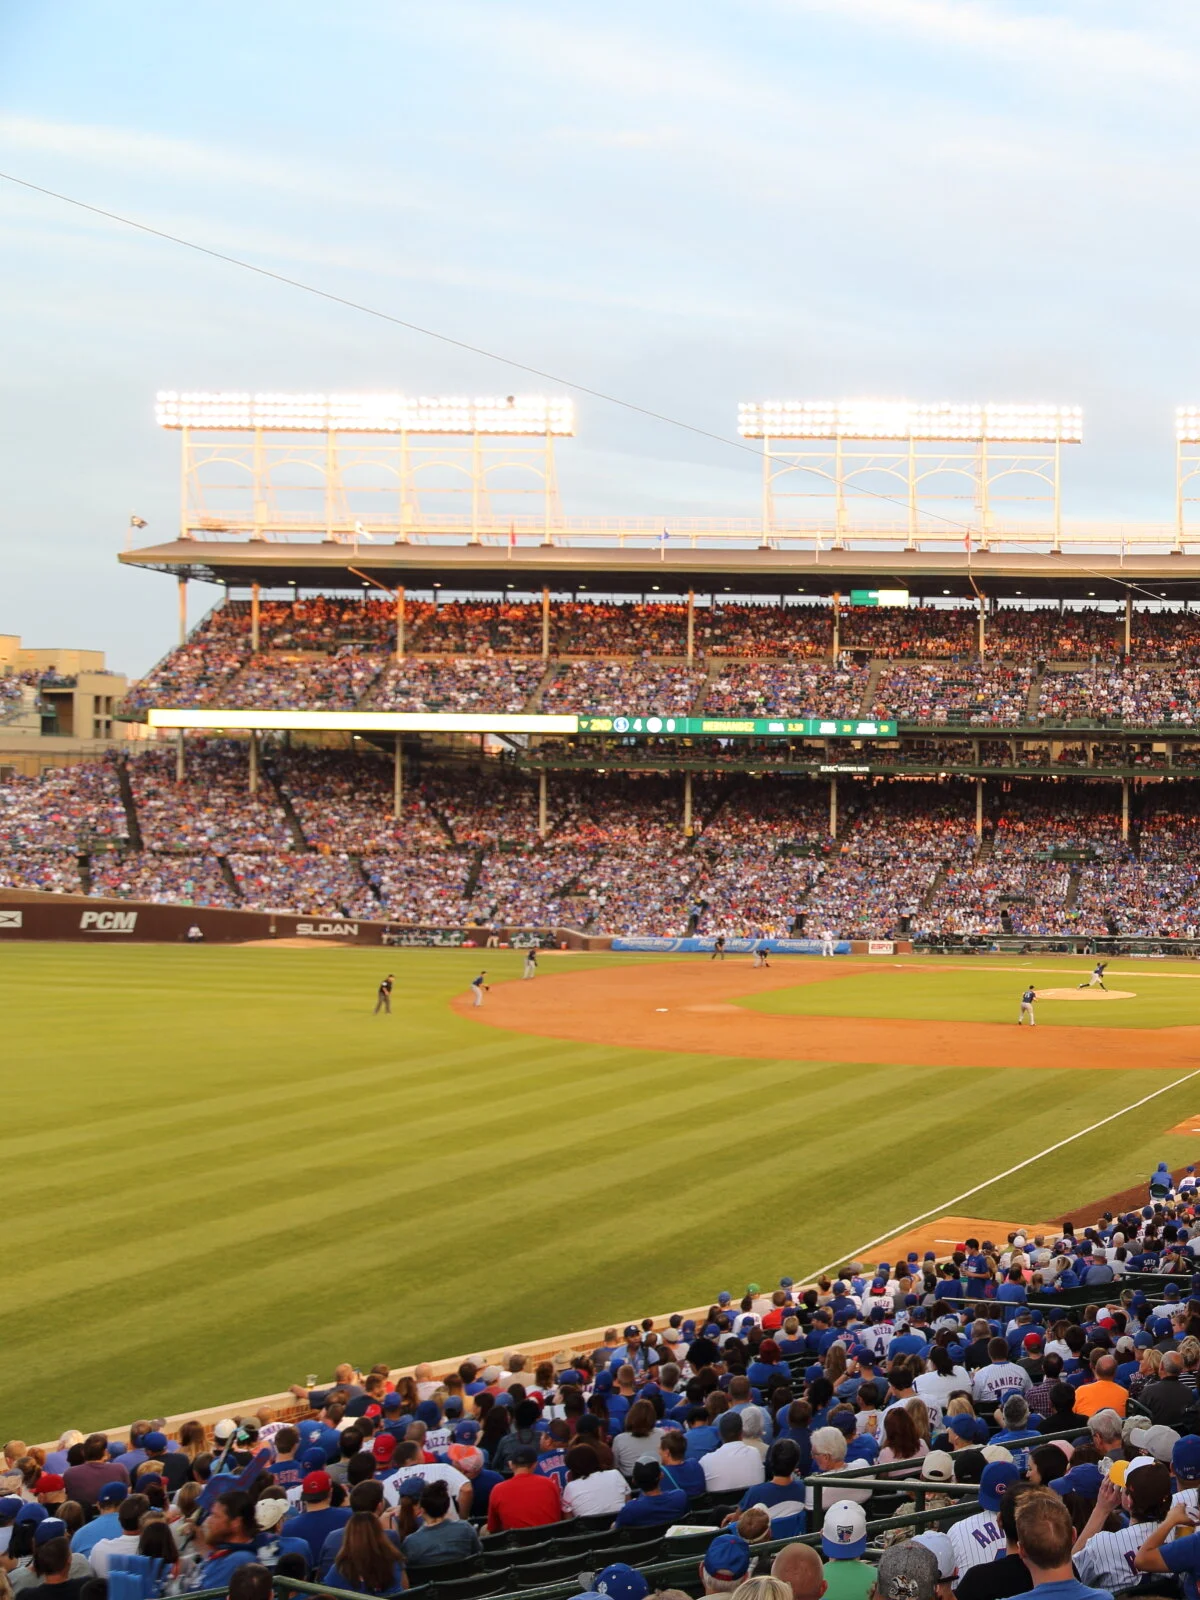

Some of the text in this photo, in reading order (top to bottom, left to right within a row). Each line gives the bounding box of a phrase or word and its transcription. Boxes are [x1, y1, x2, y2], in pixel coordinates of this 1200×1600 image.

[80, 911, 137, 929] PCM
[296, 923, 358, 936] SLOAN
[874, 1336, 885, 1355] 4
[987, 1376, 1024, 1391] RAMIREZ
